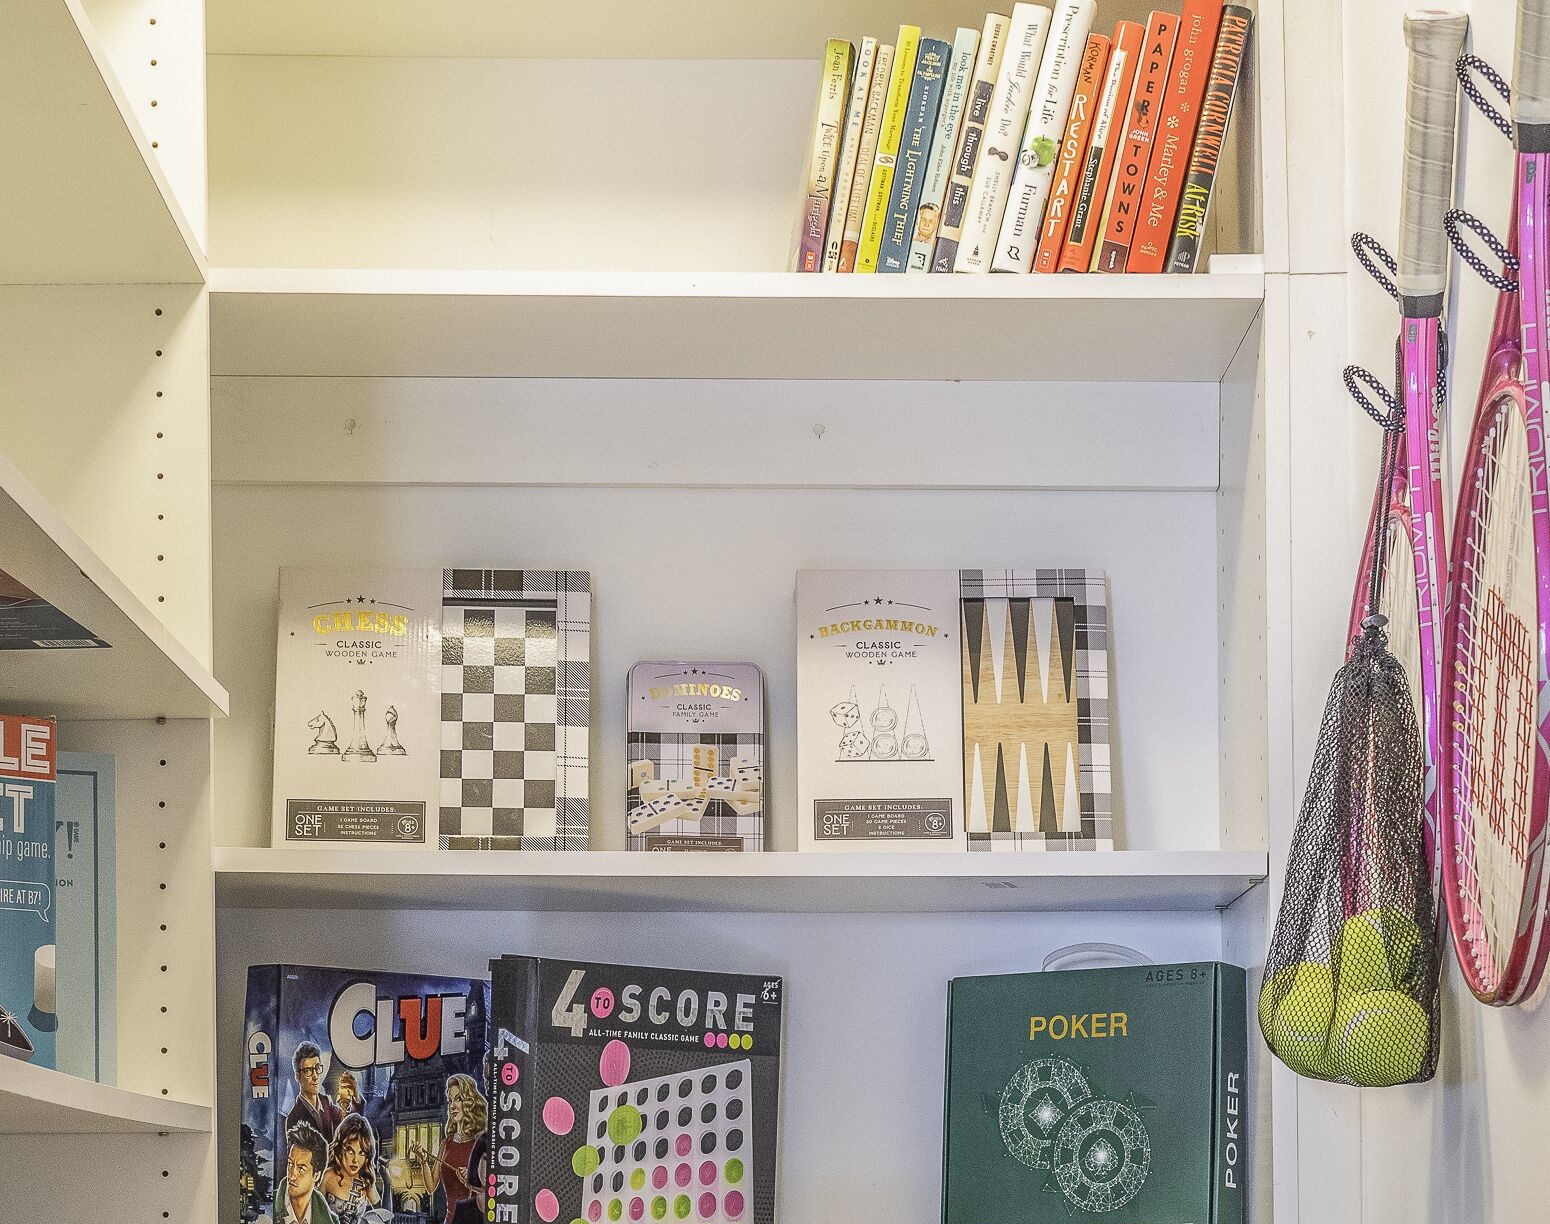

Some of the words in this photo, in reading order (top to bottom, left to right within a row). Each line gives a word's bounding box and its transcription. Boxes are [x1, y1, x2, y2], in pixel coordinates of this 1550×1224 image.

[993, 23, 1002, 39] DEBRA
[1023, 24, 1039, 47] What
[1189, 14, 1204, 45] john
[1051, 5, 1080, 80] Prescription
[1209, 14, 1248, 87] PATRICIA
[832, 48, 844, 71] Jean
[860, 40, 873, 78] LOOK
[959, 52, 972, 74] look
[1015, 51, 1032, 79] Would
[1082, 41, 1101, 83] KORMAN
[1139, 23, 1168, 115] PAPER
[955, 75, 964, 90] me
[1178, 49, 1196, 95] grogan
[856, 87, 865, 101] AT
[894, 76, 906, 108] Transform
[953, 91, 961, 103] in
[1004, 72, 1021, 115] Jackie
[1047, 83, 1058, 99] for
[864, 91, 882, 135] BACKMAN
[918, 86, 930, 123] RIORDAN
[949, 104, 960, 121] the
[972, 98, 984, 117] live
[1040, 98, 1058, 125] Life
[852, 111, 861, 127] ME
[998, 117, 1012, 137] Do?
[1097, 118, 1107, 139] Alice
[886, 124, 897, 150] Marriage
[911, 128, 923, 147] THE
[944, 123, 955, 140] eye
[1128, 134, 1150, 143] GREEN
[1131, 128, 1149, 138] JOHN
[1189, 91, 1231, 175] CORNWELL
[960, 131, 979, 173] through
[1153, 133, 1180, 185] Marley
[1047, 94, 1087, 238] RESTART
[899, 150, 922, 210] LIGHTNING
[1080, 158, 1098, 202] Stephanie
[1114, 144, 1142, 234] TOWNS
[953, 187, 966, 205] this
[1154, 186, 1169, 201] &
[1183, 182, 1209, 202] At
[808, 184, 829, 238] Marigold
[1013, 183, 1037, 237] Furman
[1074, 203, 1088, 228] Grant
[1147, 202, 1165, 227] Me
[1175, 203, 1206, 240] Risk
[892, 213, 907, 245] THIEF
[312, 613, 410, 637] CHESS
[817, 619, 939, 639] BACKGAMMON
[325, 650, 370, 659] WOODEN
[372, 650, 398, 659] GAME
[336, 639, 383, 650] CLASSIC
[855, 641, 902, 650] CLASSIC
[676, 703, 712, 711] CLASSIC
[295, 814, 322, 825] ONE
[295, 825, 322, 836] SET
[404, 823, 416, 833] 8+
[823, 814, 850, 825] ONE
[823, 824, 850, 836] SET
[931, 819, 943, 829] 8+
[17, 841, 51, 862] game.
[16, 890, 27, 904] AT
[28, 890, 42, 905] B7!
[763, 981, 779, 989] AGES
[1145, 969, 1184, 983] AGES
[1190, 968, 1207, 980] 8+
[551, 969, 588, 1038] 4
[595, 997, 610, 1010] TO
[618, 984, 756, 1032] SCORE
[329, 982, 468, 1070] CLUE
[588, 1028, 622, 1038] ALL-TIME
[623, 1030, 649, 1040] FAMILY
[650, 1032, 680, 1041] CLASSIC
[680, 1034, 699, 1043] GAME
[1029, 1011, 1129, 1041] POKER
[494, 1028, 530, 1061] 4
[248, 1031, 272, 1100] CLUE
[505, 1066, 513, 1081] TO
[1224, 1071, 1240, 1190] POKER
[495, 1090, 522, 1224] SCORE
